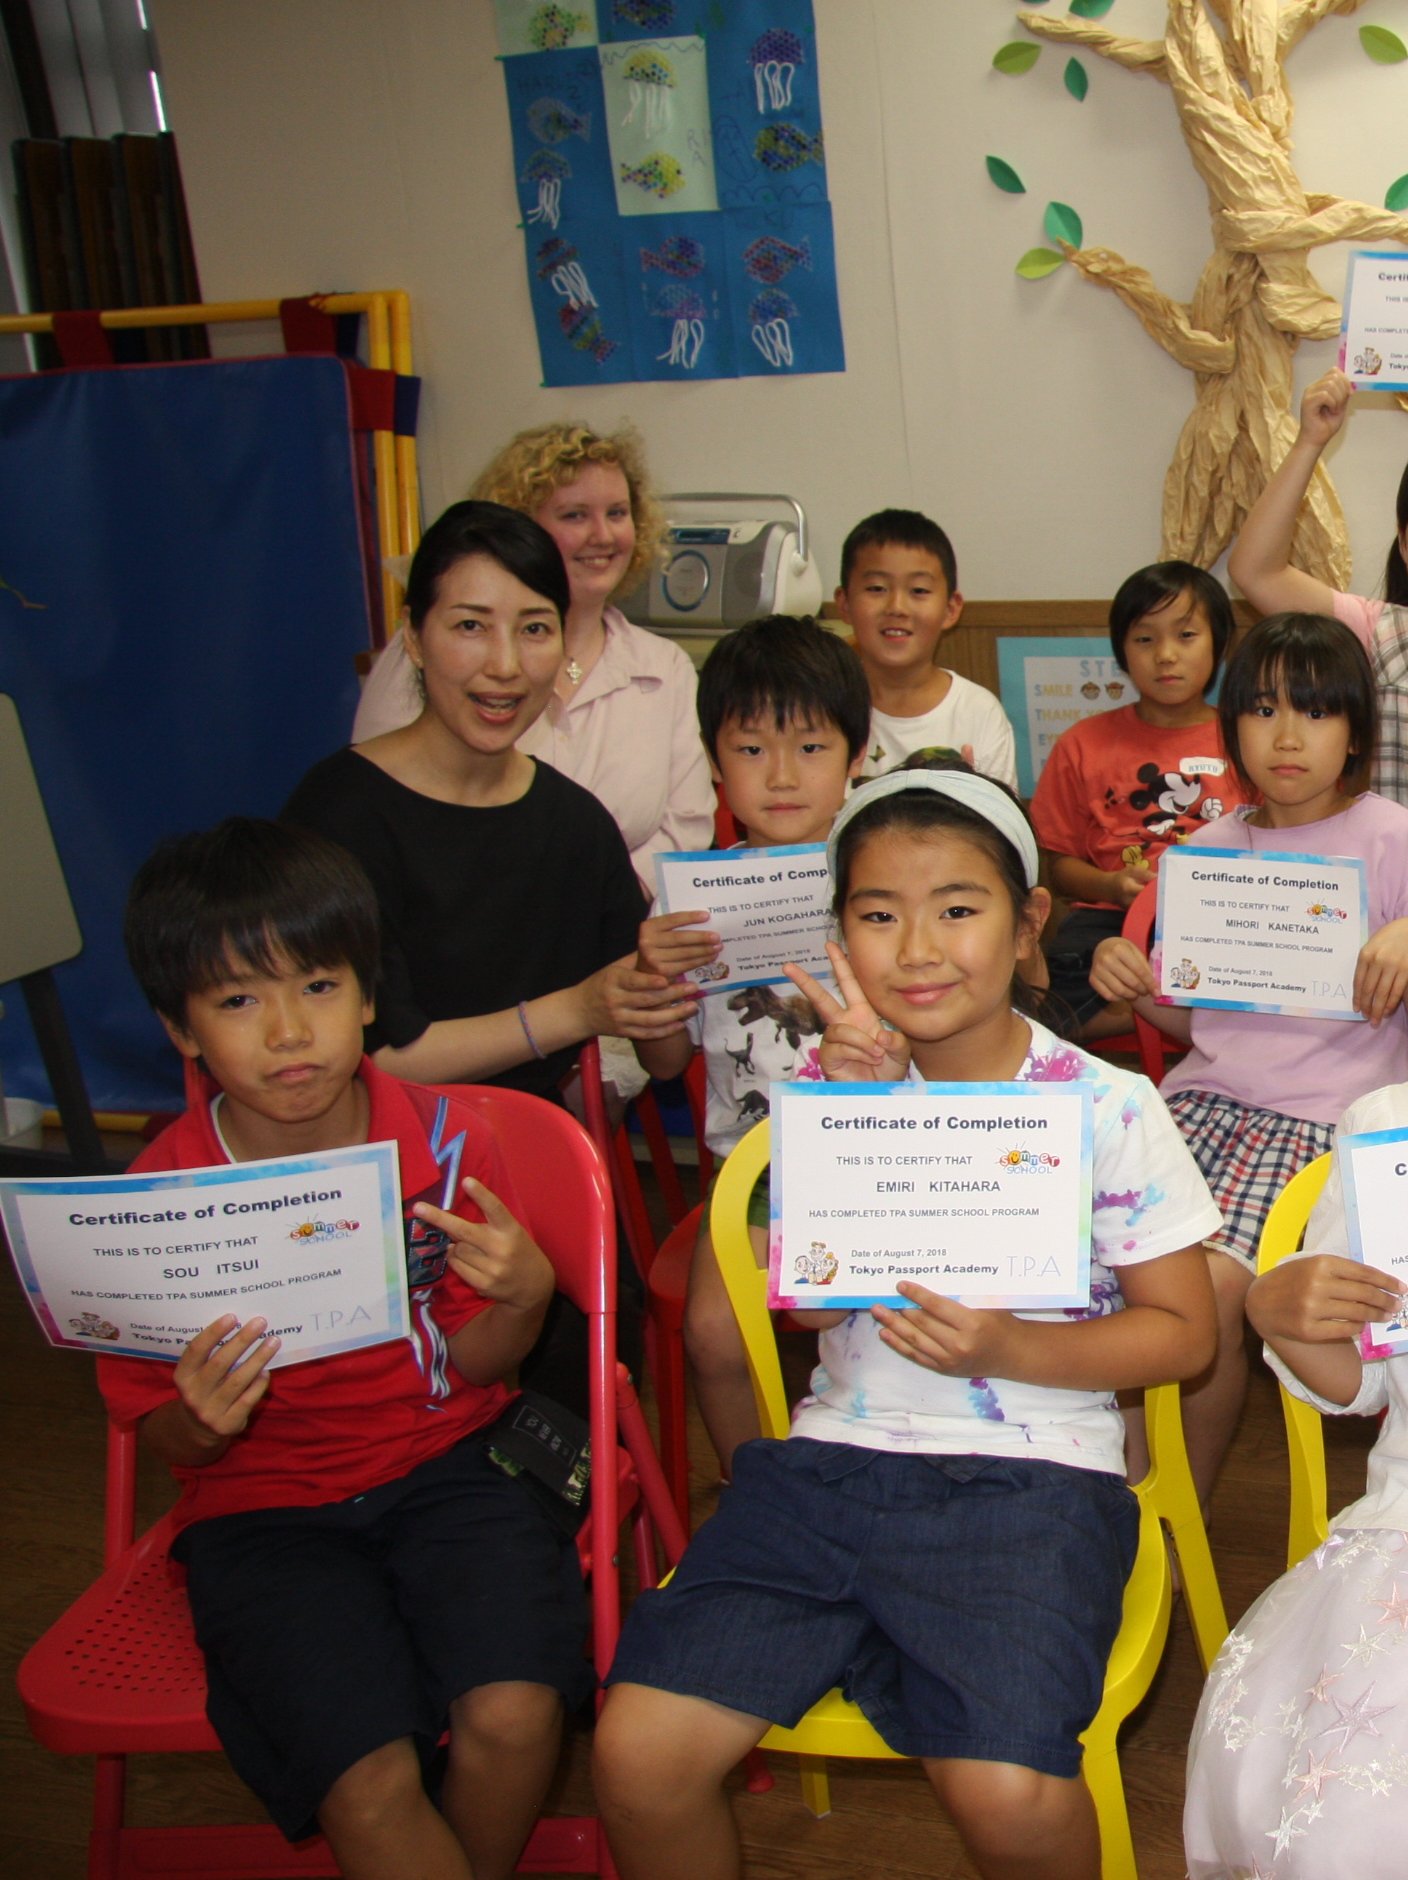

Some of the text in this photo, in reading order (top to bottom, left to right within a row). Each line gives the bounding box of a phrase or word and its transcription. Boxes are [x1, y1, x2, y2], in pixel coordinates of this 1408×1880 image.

[693, 868, 828, 888] Certificate of Comp
[1192, 871, 1338, 891] Certificate of Completion
[708, 906, 727, 914] THIS
[754, 898, 789, 909] CERTIFY
[792, 895, 814, 904] THAT
[1239, 902, 1269, 911] CERTIFY
[744, 908, 833, 927] JUN KOGAHARA
[1226, 920, 1319, 934] MIHORI KANETAKA
[1208, 978, 1306, 992] Tokyo Passport Academy
[821, 1116, 1047, 1131] Certificate of Completion
[836, 1156, 972, 1165] THIS IS TO CERTIFY THAT
[877, 1181, 1000, 1192] EMIRI KITAHARA
[69, 1188, 342, 1226] Certificate of Completion
[890, 1209, 906, 1217] TPA
[909, 1209, 948, 1217] SUMMER
[992, 1208, 1039, 1216] PROGRAM
[93, 1235, 258, 1257] THIS IS TO CERTIFY THAT
[884, 1249, 914, 1258] August
[927, 1248, 946, 1256] 2018
[163, 1259, 259, 1279] SOU ITSUI
[850, 1265, 998, 1276] Tokyo Passport Academy
[71, 1268, 342, 1301] HAS COMPLETED TPA SUMMER SCHOOL PROGRAM
[130, 1322, 153, 1331] Date
[155, 1323, 166, 1332] of
[132, 1333, 171, 1346] Tokyo
